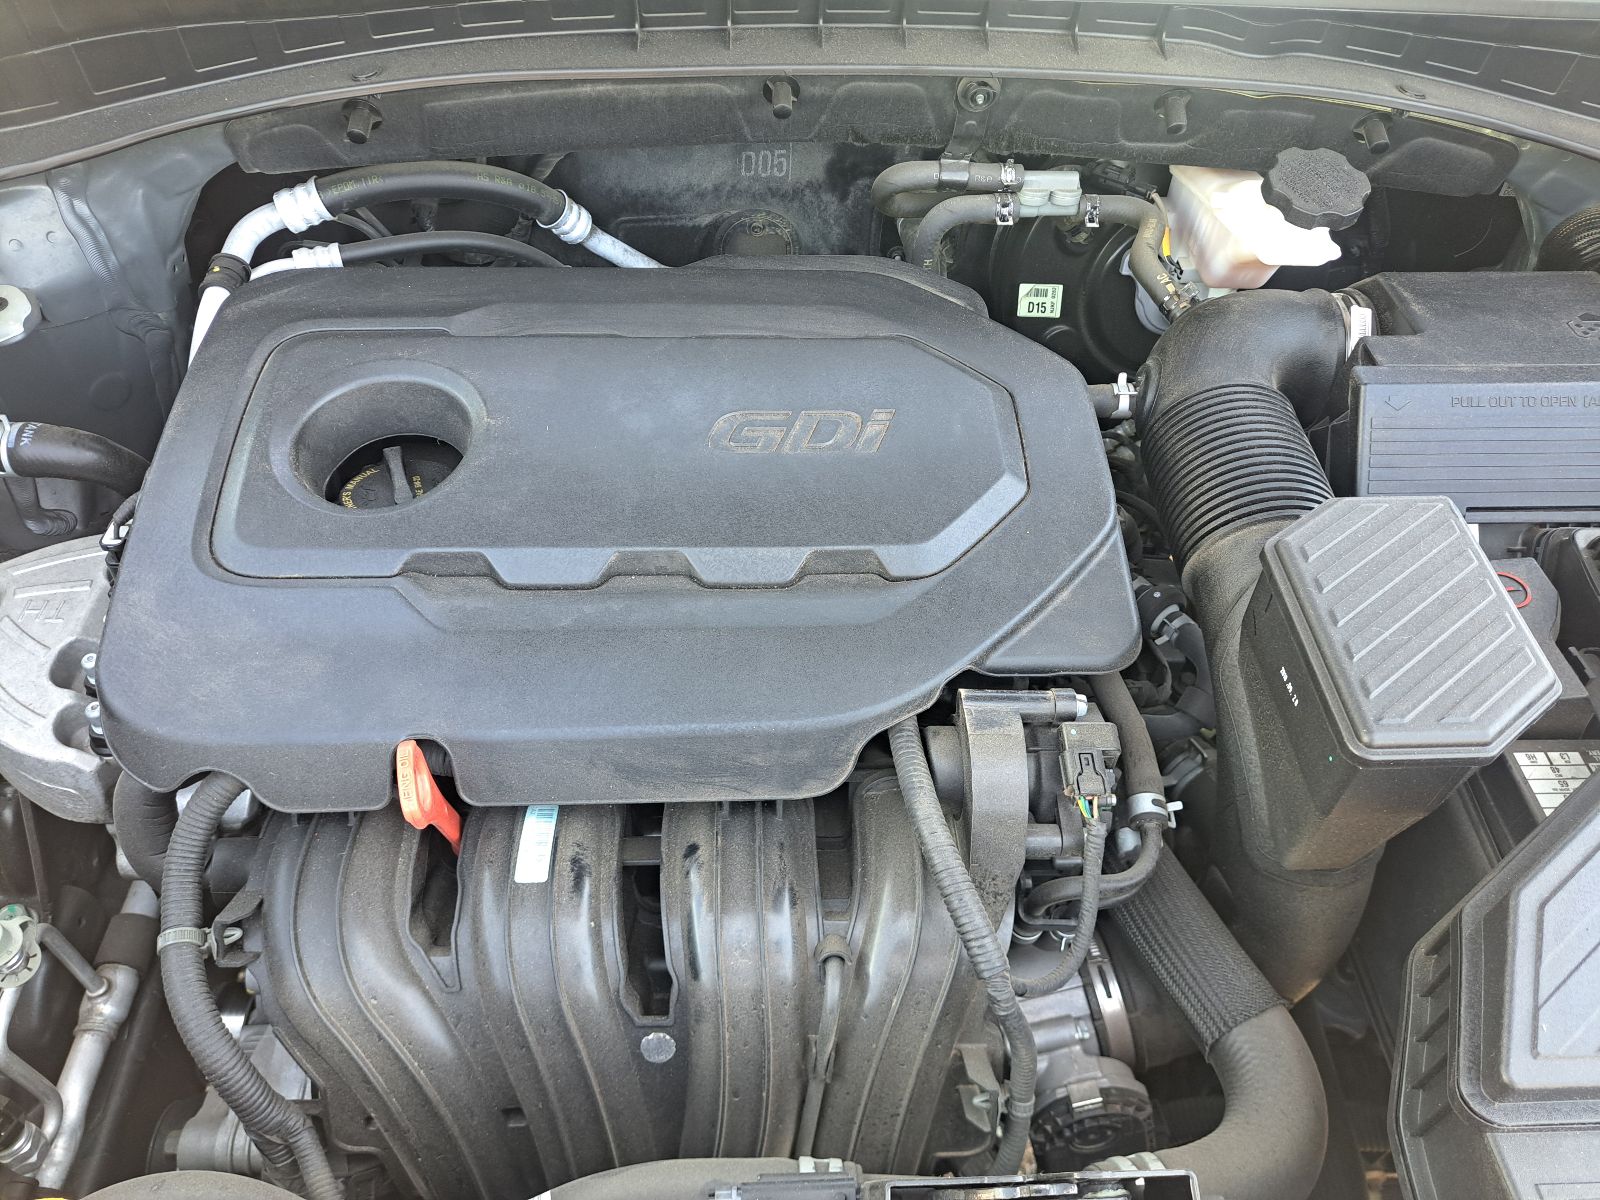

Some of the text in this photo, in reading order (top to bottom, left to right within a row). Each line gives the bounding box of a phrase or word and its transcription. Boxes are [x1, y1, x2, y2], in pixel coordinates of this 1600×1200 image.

[1027, 301, 1047, 314] D15
[1451, 395, 1486, 408] PULL
[1488, 395, 1515, 408] OUT
[1517, 395, 1537, 408] TO
[1540, 395, 1577, 408] OPEN
[706, 408, 896, 453] GDi
